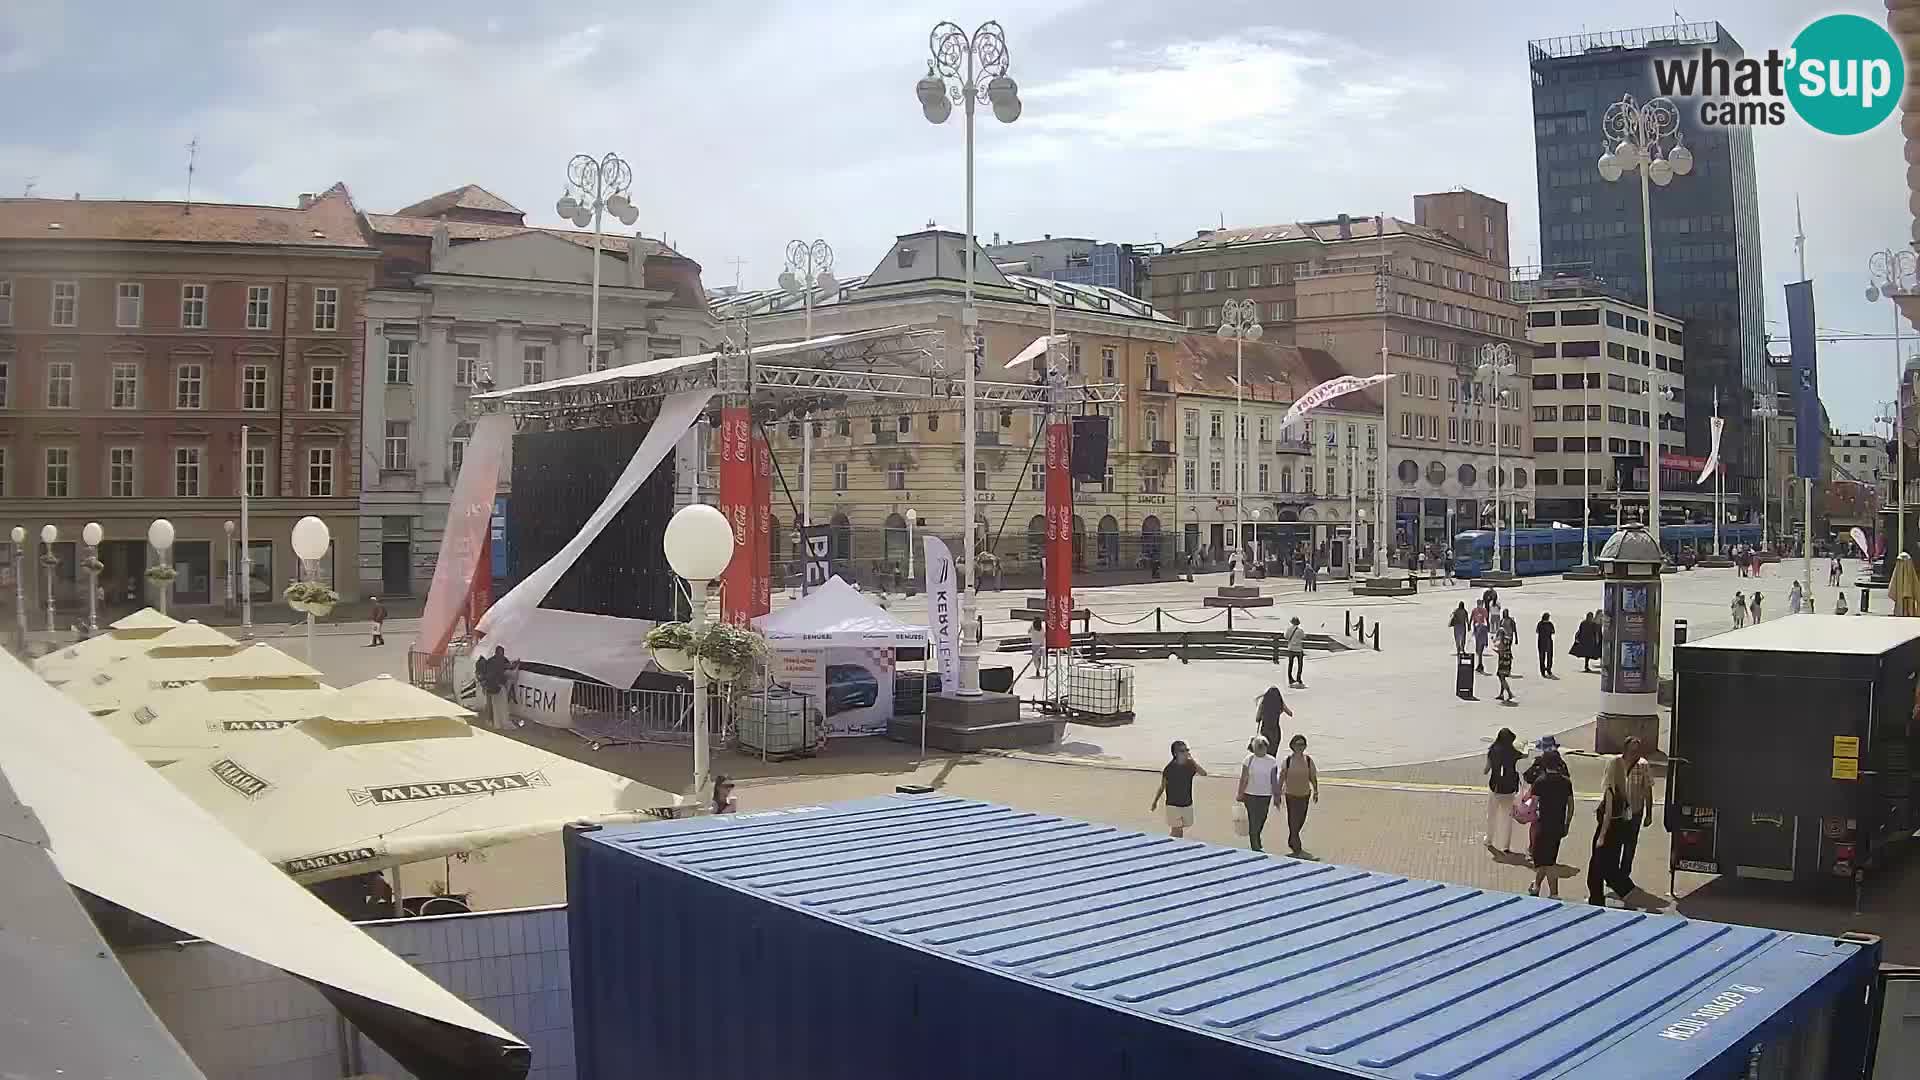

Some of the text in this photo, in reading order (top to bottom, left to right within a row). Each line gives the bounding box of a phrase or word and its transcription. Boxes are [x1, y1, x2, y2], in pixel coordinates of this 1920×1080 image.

[735, 420, 748, 461] Coca-Cola
[735, 504, 746, 545] Coca-Cola
[382, 777, 521, 801] MARASKA
[290, 849, 372, 872] MARASKA
